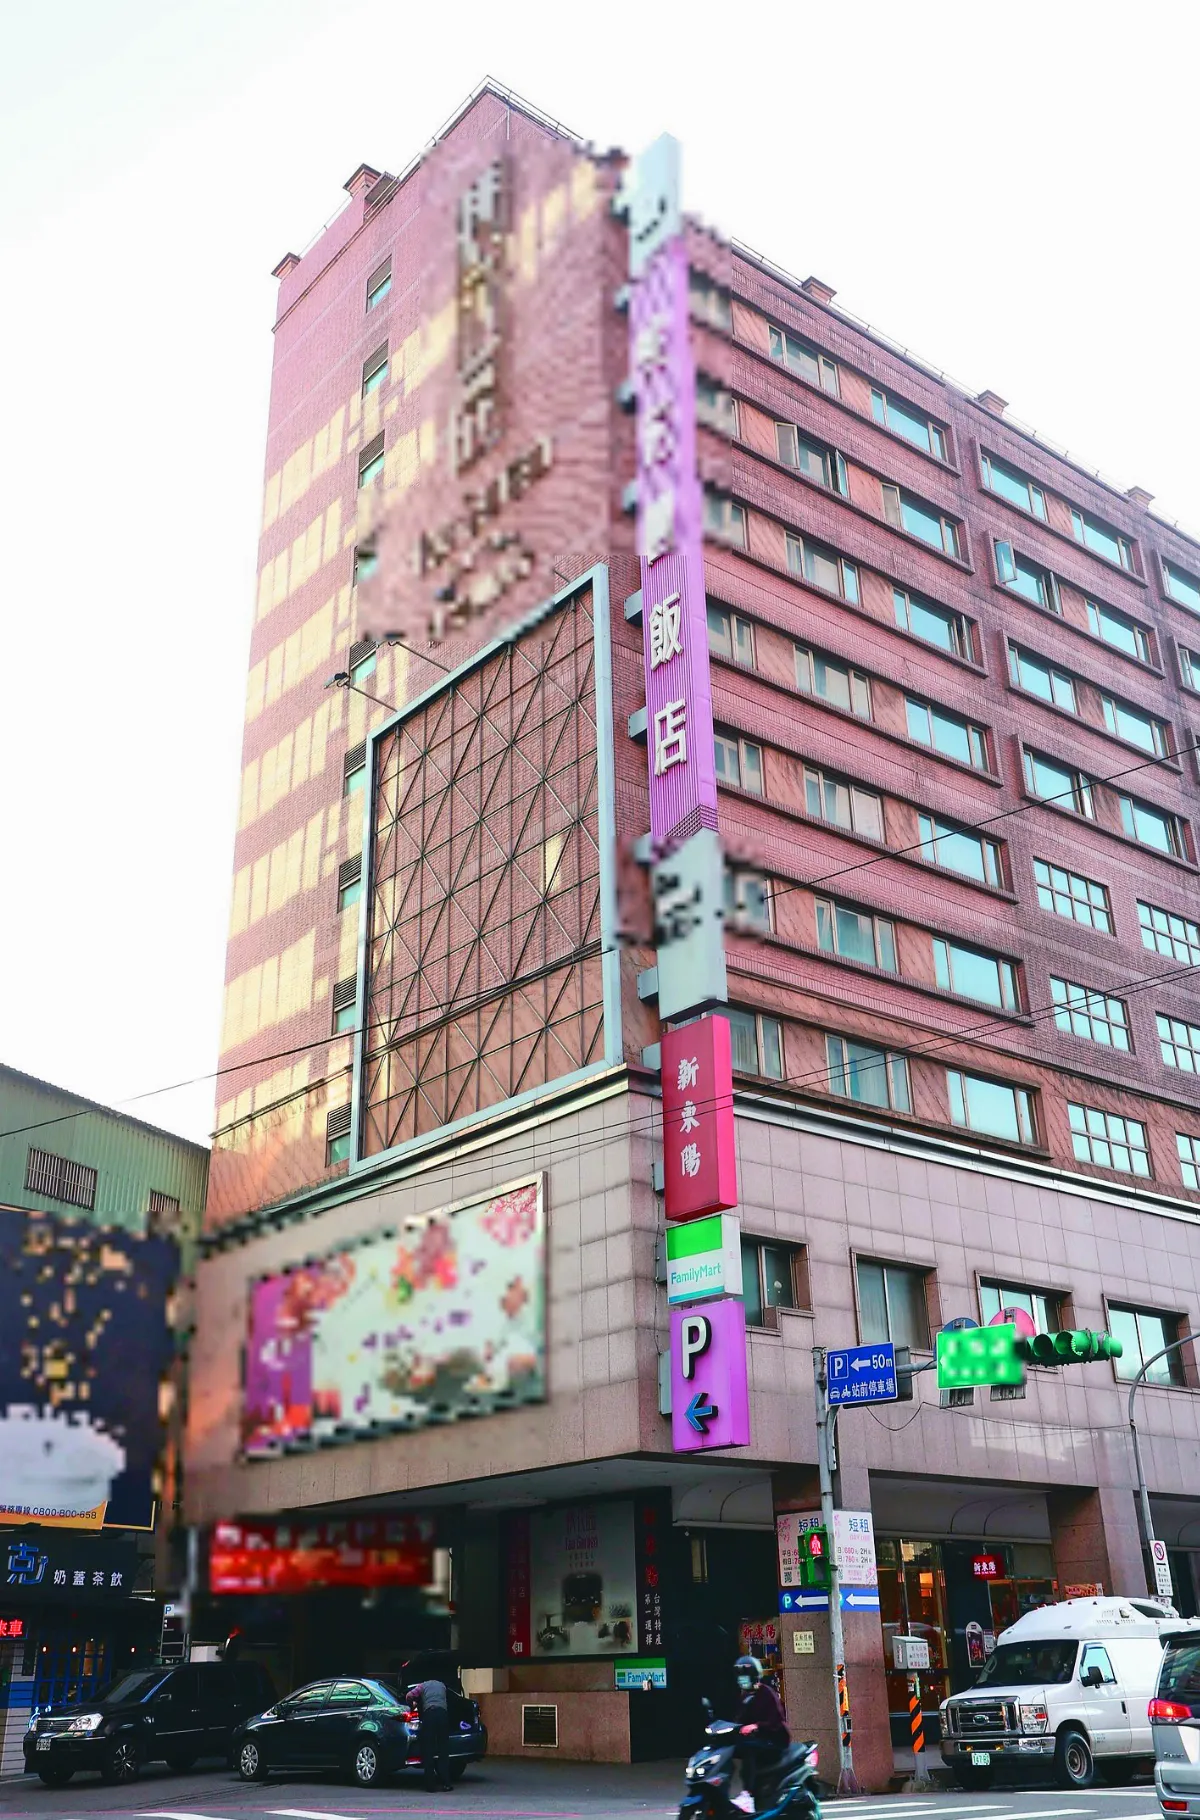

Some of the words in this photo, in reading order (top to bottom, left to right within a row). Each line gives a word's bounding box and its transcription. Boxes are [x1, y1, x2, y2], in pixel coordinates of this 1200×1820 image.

[648, 592, 688, 778] 飯店
[677, 1056, 701, 1178] 新東陽
[670, 1262, 722, 1285] FamilyMart
[681, 1316, 711, 1380] P
[834, 1357, 844, 1377] P
[872, 1353, 893, 1370] 50m
[851, 1378, 895, 1398] 站前停車場
[32, 1506, 97, 1520] 0800-800-658
[848, 1518, 870, 1533] 短租
[53, 1569, 123, 1587] 奶蓋茶飲
[784, 1595, 792, 1609] P
[743, 1624, 776, 1640] 新東陽
[627, 1671, 665, 1683] FamilyMart
